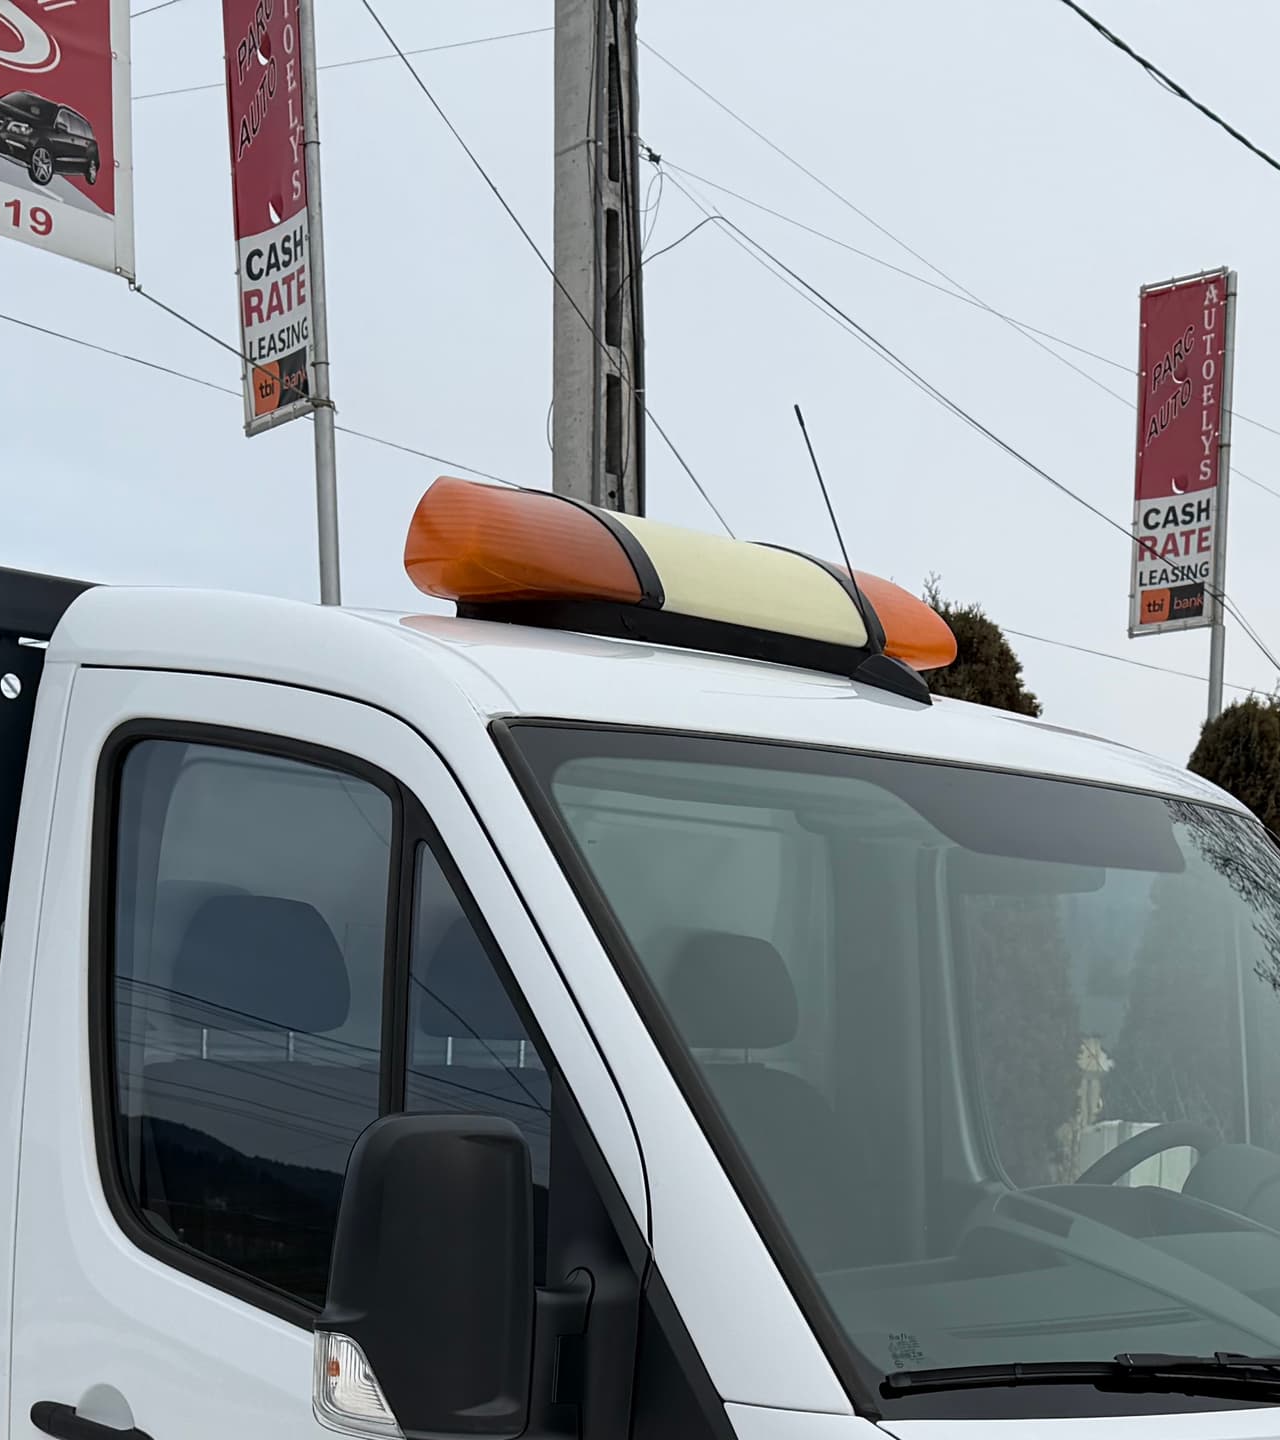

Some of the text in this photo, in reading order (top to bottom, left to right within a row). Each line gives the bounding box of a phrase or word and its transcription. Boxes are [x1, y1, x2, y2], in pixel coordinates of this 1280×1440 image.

[237, 56, 277, 162] AUTO
[246, 225, 304, 281] CASH
[243, 264, 307, 328] RATE
[249, 316, 309, 362] LEASING
[1151, 325, 1195, 394] PARC
[258, 377, 275, 399] tbi
[1199, 284, 1218, 481] AUTOELYS
[1145, 378, 1193, 447] AUTO
[1142, 498, 1211, 530] CASH
[1138, 526, 1212, 562] RATE
[1138, 561, 1210, 588] LEASING
[1145, 594, 1204, 613] tbi bank
